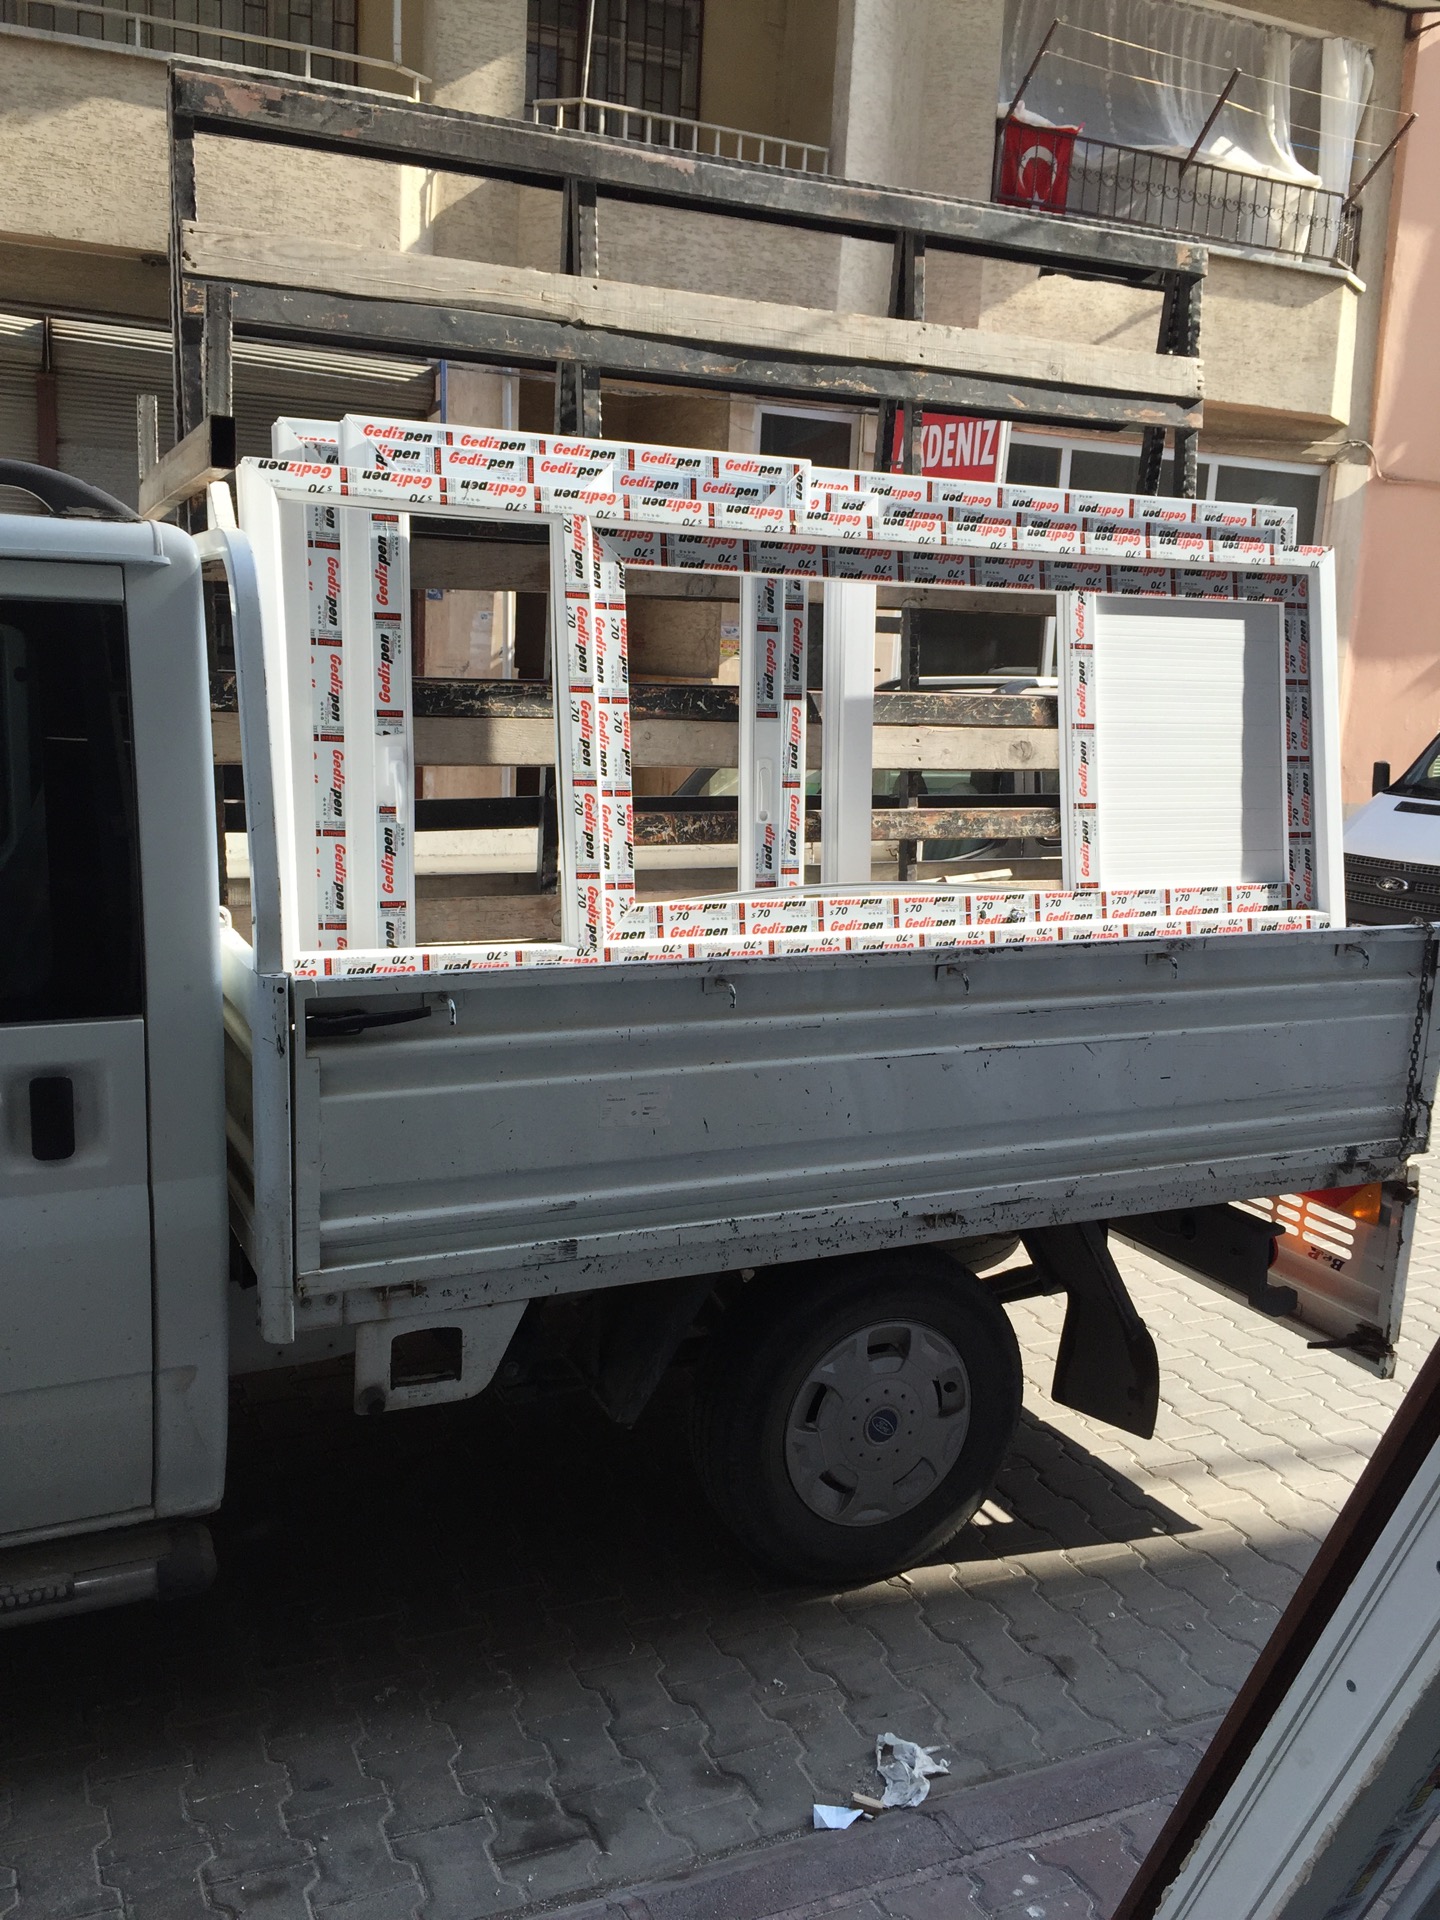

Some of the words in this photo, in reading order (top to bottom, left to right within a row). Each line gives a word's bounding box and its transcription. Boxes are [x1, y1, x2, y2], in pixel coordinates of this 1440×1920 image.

[363, 424, 432, 443] Gedizpen
[460, 434, 526, 452] Gedizpen
[553, 443, 616, 460] Gedizpen
[896, 420, 998, 468] DENIZ
[258, 459, 332, 479] Gedizpen
[449, 452, 514, 470] Gedizpen
[641, 452, 702, 468] Gedizpen
[725, 460, 782, 476] Gedizpen
[362, 470, 432, 489] Gedizpen
[620, 475, 679, 492] Gedizpen
[554, 488, 616, 506] Gedizpen
[702, 482, 759, 498] Gedizpen
[642, 497, 702, 514] Gedizpen
[726, 505, 784, 520] Gedizpen
[807, 511, 861, 526] Gedizpen
[883, 518, 936, 532] Gedizpen
[957, 524, 1006, 537] Gedizpen
[375, 535, 391, 606] Gedizpen
[325, 556, 340, 626] Gedizpen
[575, 606, 590, 674] Gedizpen
[790, 617, 803, 681] Gedizpen
[378, 634, 394, 703] Gedizpen
[764, 639, 776, 700] Gedizpen
[328, 654, 343, 722] Gedizpen
[579, 700, 594, 767] Gedizpen
[789, 707, 801, 769] Gedizpen
[330, 749, 345, 817] Gedizpen
[582, 793, 597, 859] Gedizpen
[381, 828, 396, 894] Gedizpen
